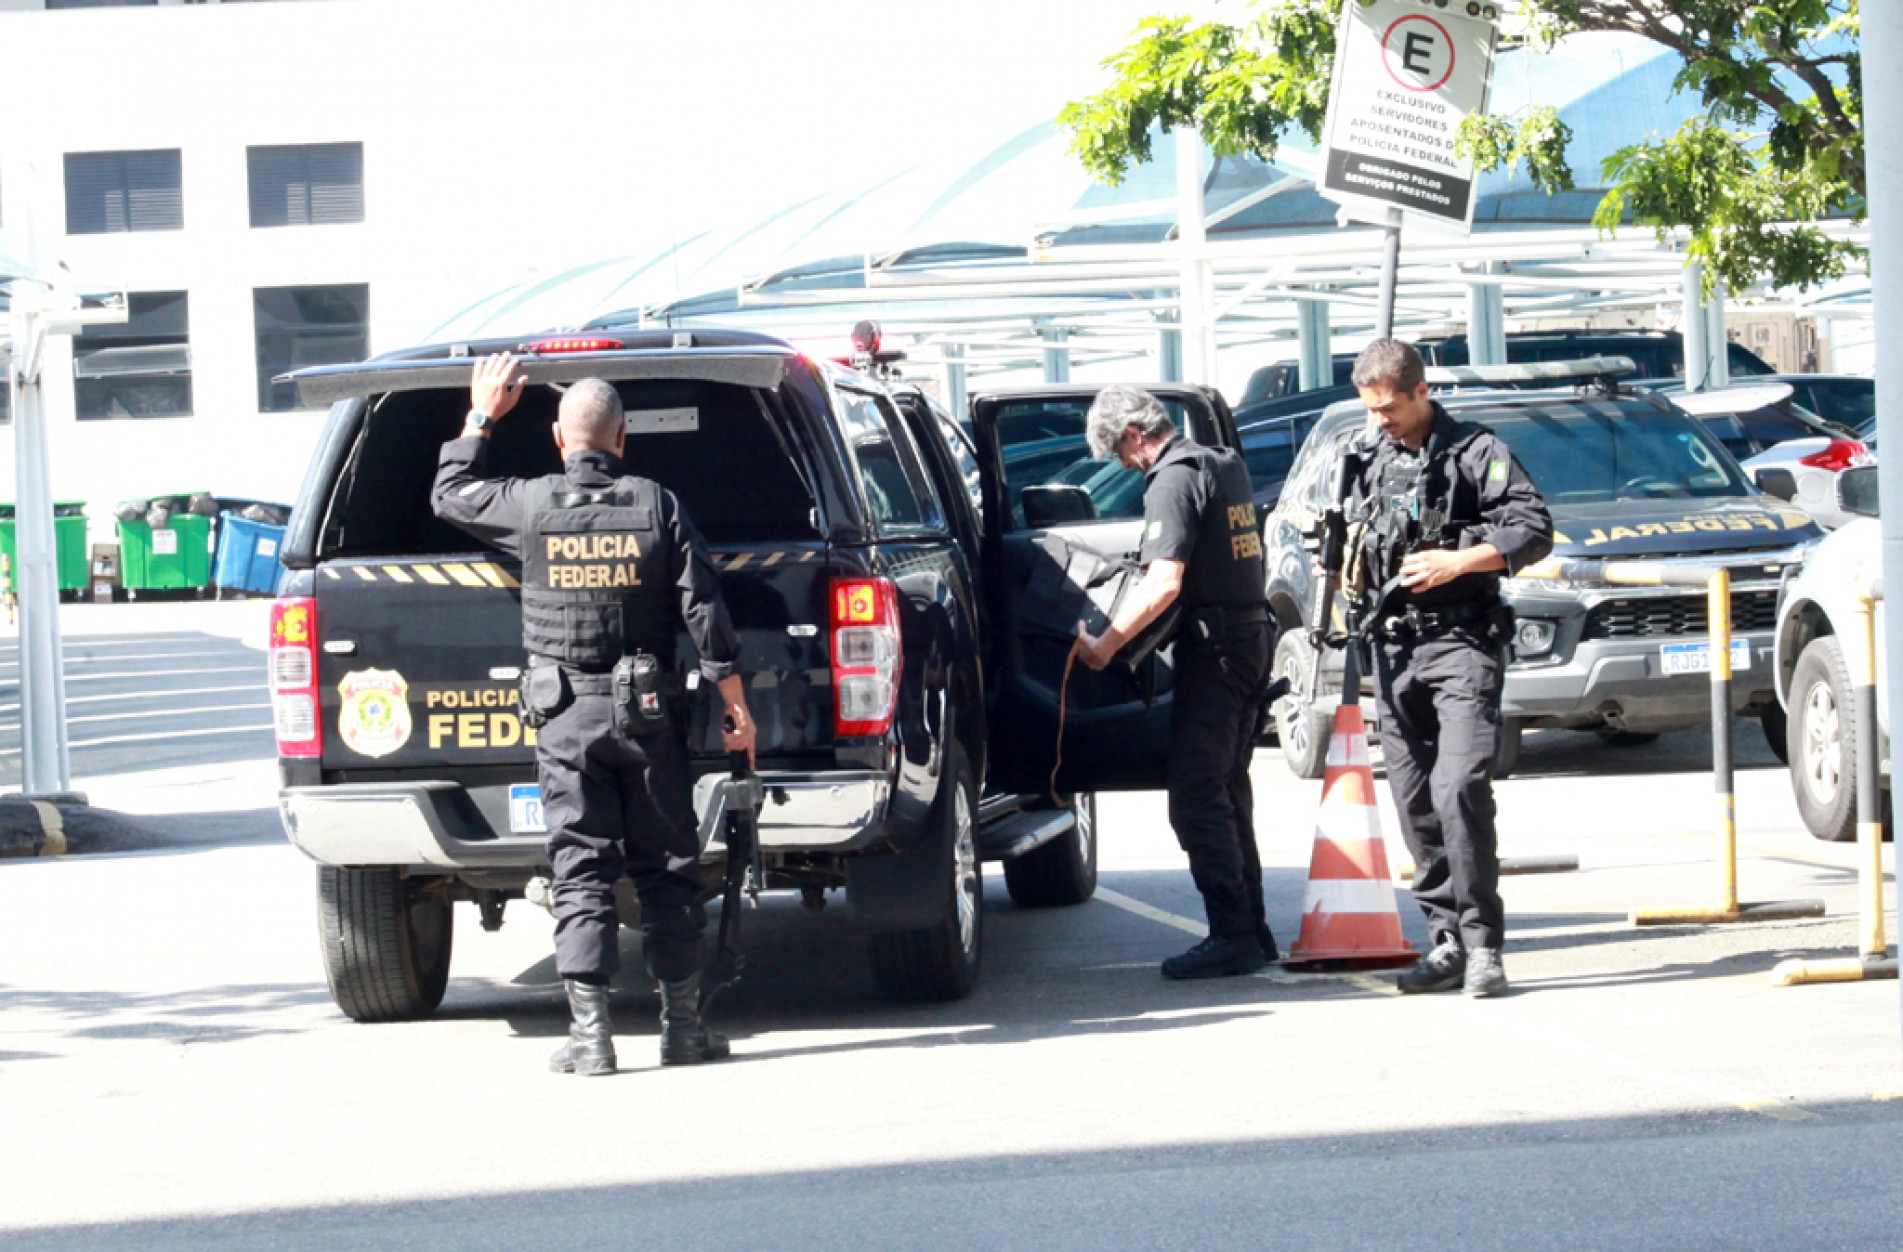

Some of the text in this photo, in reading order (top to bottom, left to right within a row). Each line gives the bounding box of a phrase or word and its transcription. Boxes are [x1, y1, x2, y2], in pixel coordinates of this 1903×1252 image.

[1403, 31, 1434, 75] E
[1376, 89, 1445, 114] EXCLUSIVO
[1370, 104, 1448, 132] SERVIDORES
[1350, 118, 1442, 148] APOSENTADOS
[1403, 146, 1458, 169] FEDERAL
[549, 563, 642, 588] FEDERAL
